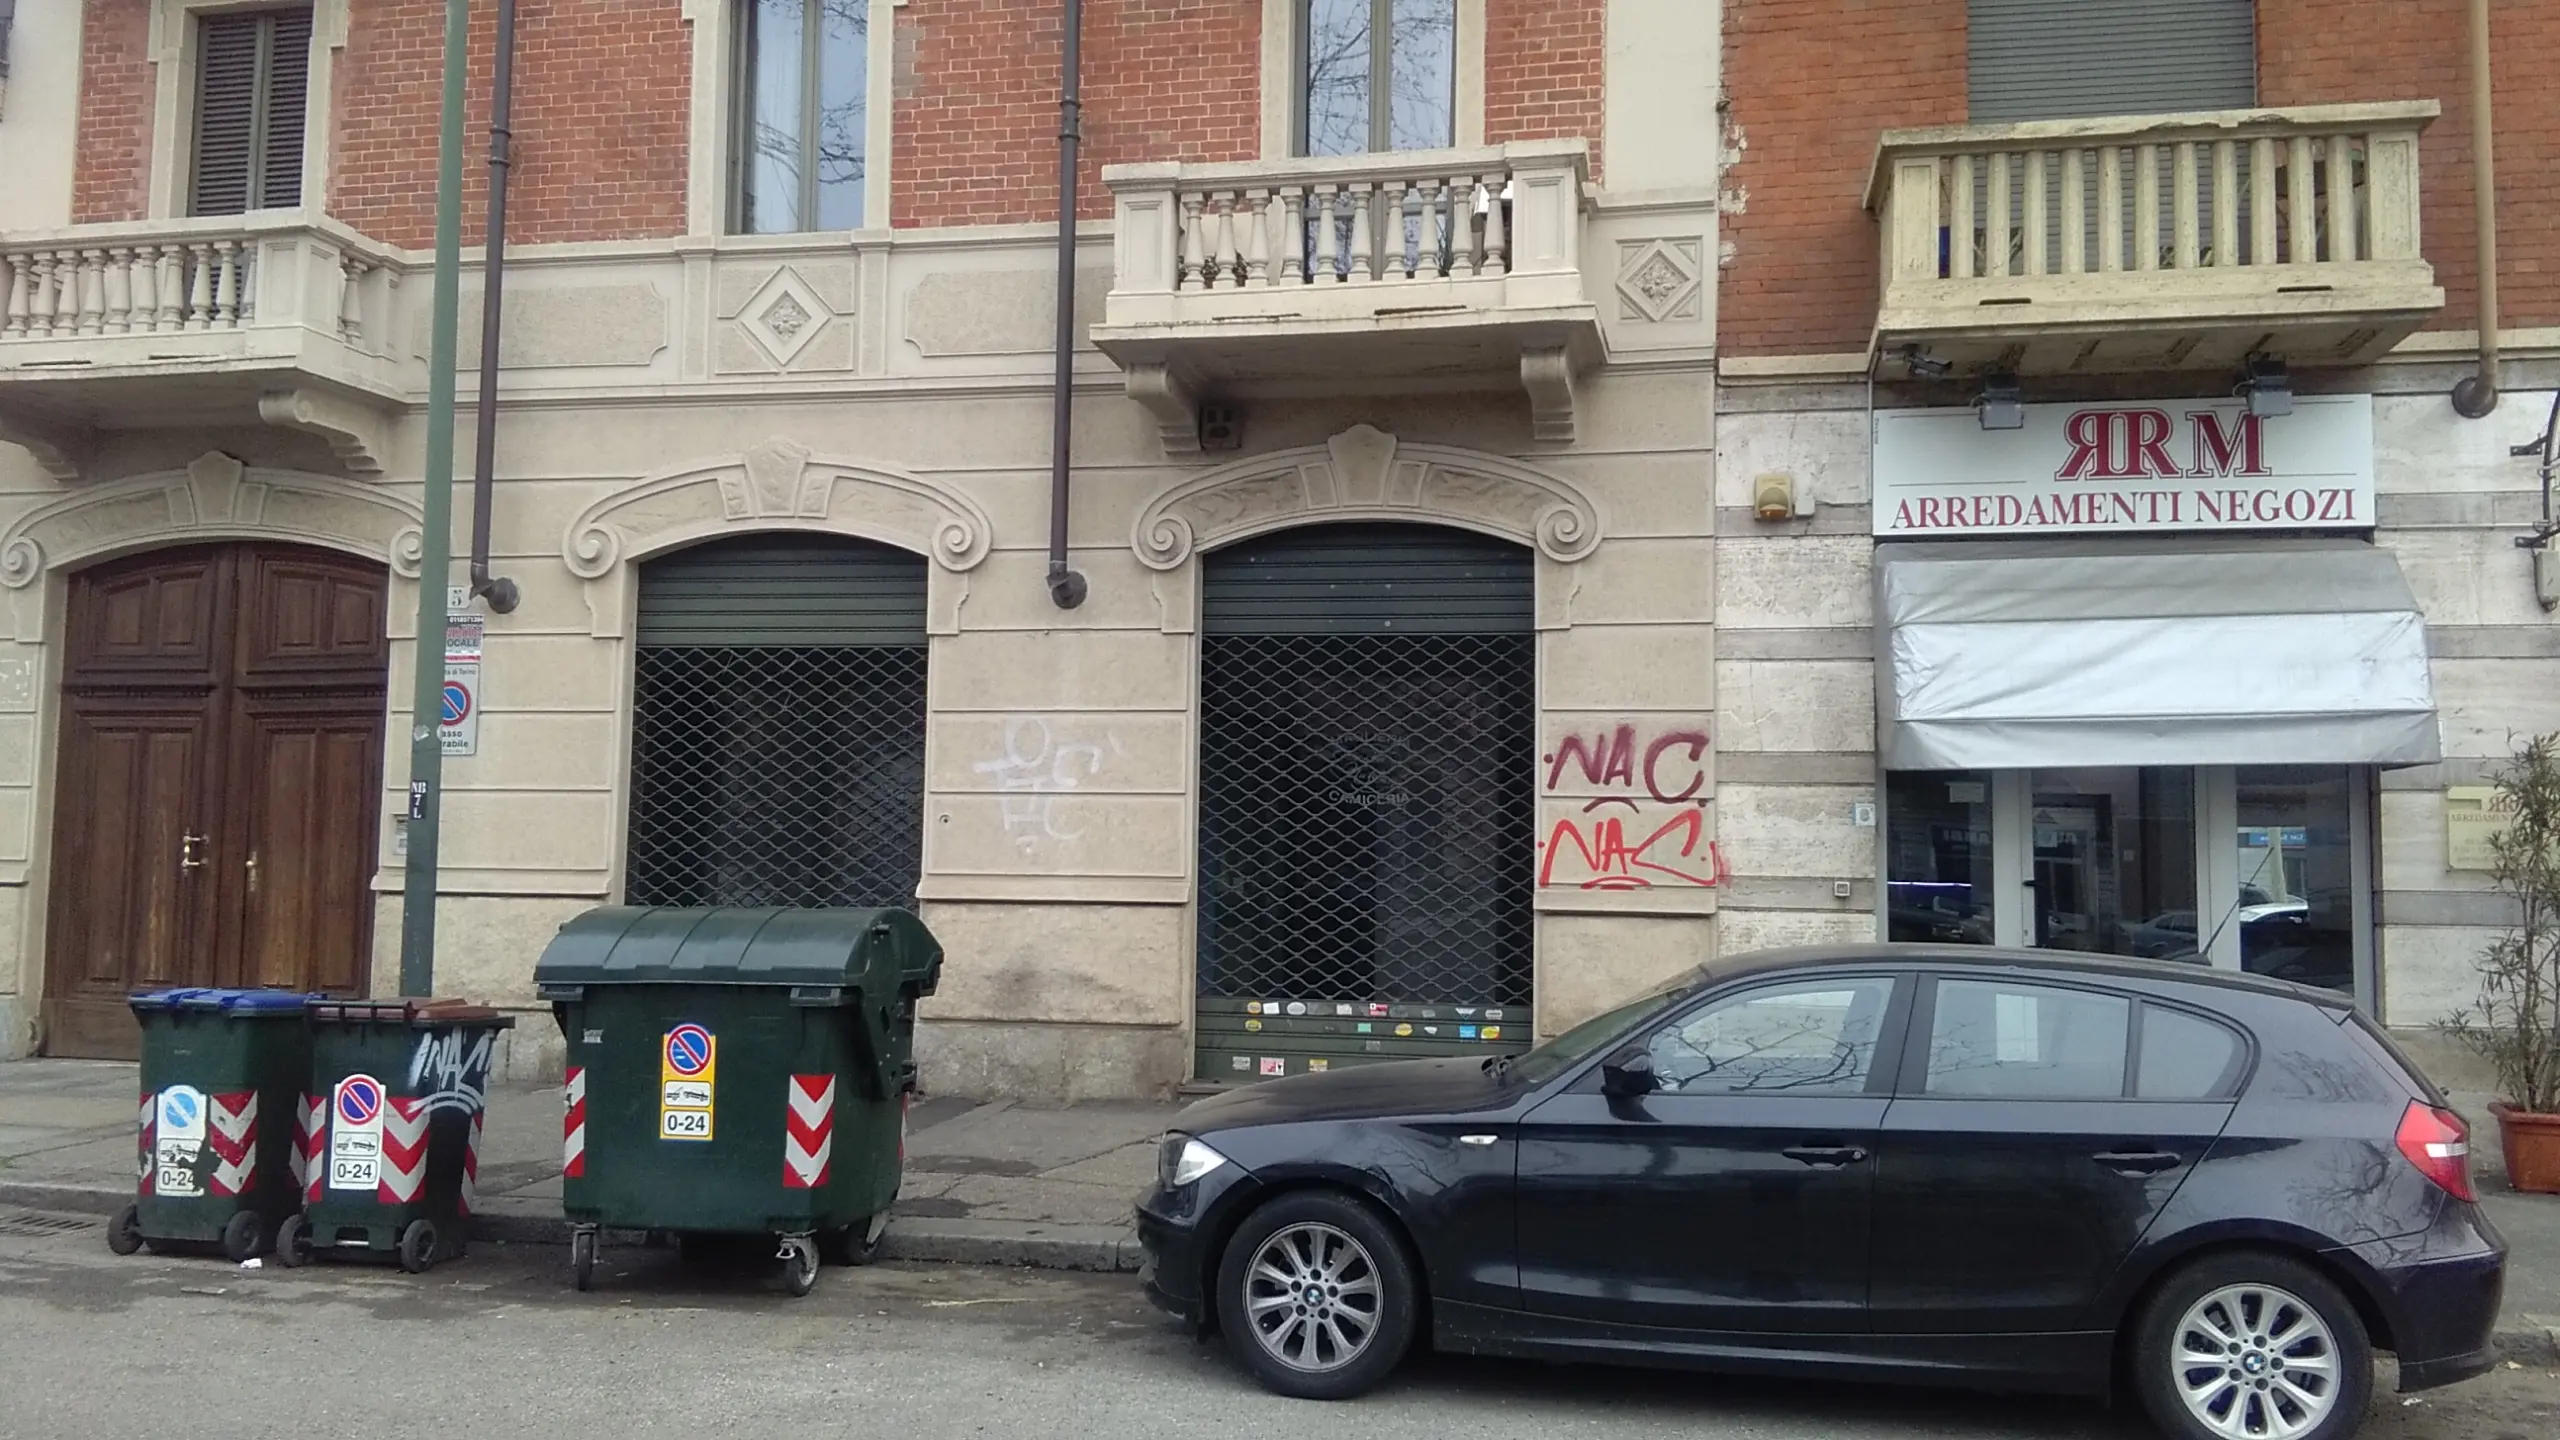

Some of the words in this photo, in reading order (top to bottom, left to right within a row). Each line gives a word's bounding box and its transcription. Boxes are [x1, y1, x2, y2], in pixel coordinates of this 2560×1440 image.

[1890, 490, 2181, 529] ARREDAMENTI
[2195, 488, 2356, 523] NEGOZI
[451, 589, 463, 606] 5
[447, 638, 479, 648] OCALE
[442, 730, 463, 738] asso
[668, 1114, 706, 1131] 0-24
[337, 1163, 372, 1179] 0-24
